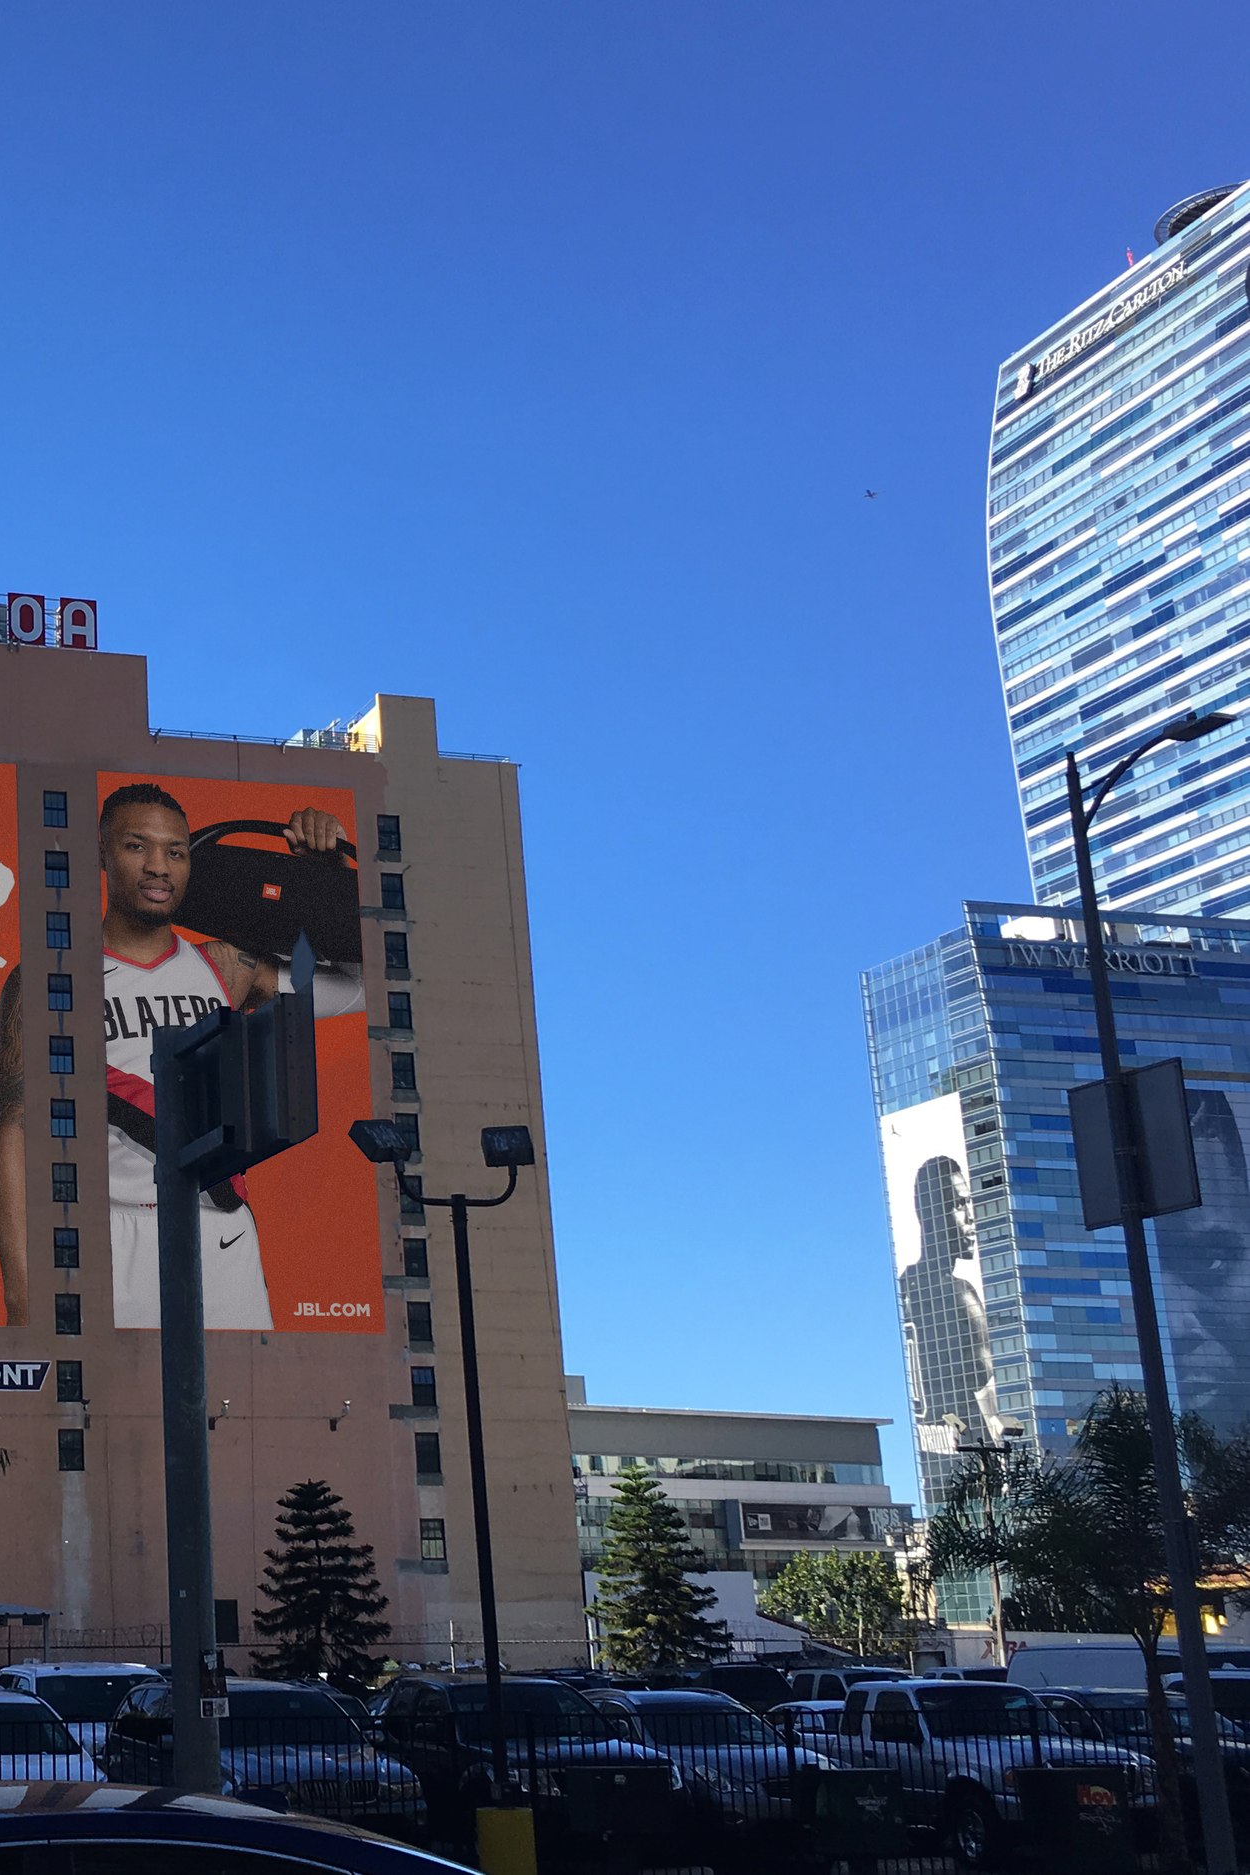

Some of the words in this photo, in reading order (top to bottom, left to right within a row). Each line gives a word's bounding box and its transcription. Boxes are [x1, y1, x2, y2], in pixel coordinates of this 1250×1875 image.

[1035, 347, 1067, 378] THE
[265, 887, 278, 896] JBL
[1006, 943, 1045, 967] JW
[293, 1302, 371, 1317] JBL.COM
[867, 1507, 889, 1523] THIS
